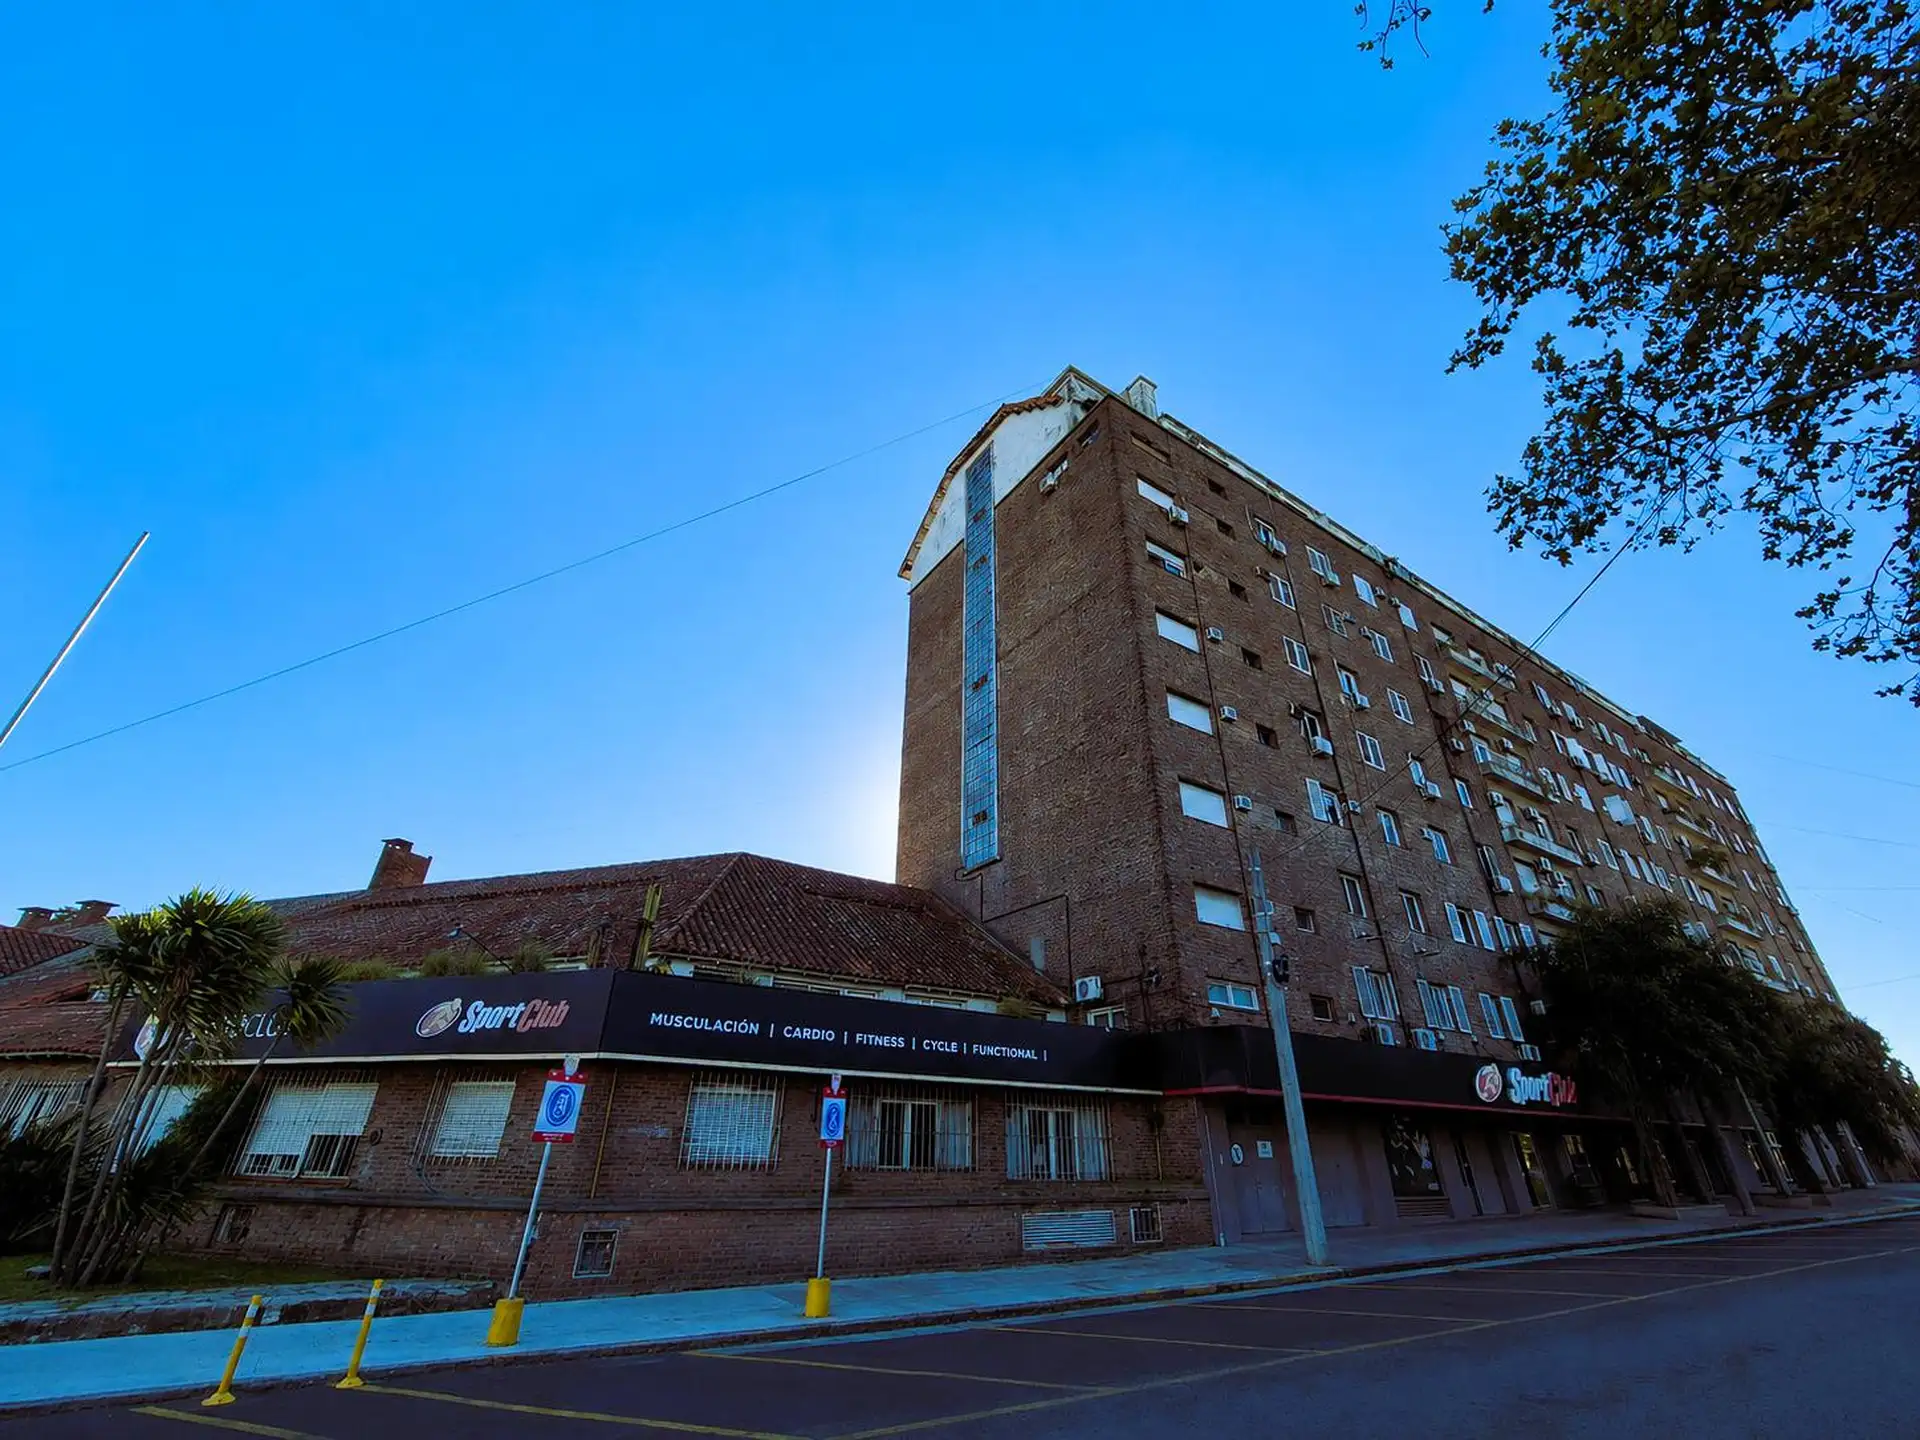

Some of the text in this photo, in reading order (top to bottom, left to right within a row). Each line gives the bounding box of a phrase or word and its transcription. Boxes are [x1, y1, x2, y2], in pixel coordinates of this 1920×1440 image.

[457, 999, 571, 1034] SportClub
[650, 1012, 760, 1035] MUSCULACIÓN
[783, 1025, 836, 1042] CARDIO
[855, 1033, 905, 1048] FITNESS
[922, 1039, 959, 1053] CYCLE
[972, 1044, 1038, 1060] FUNCTIONAL
